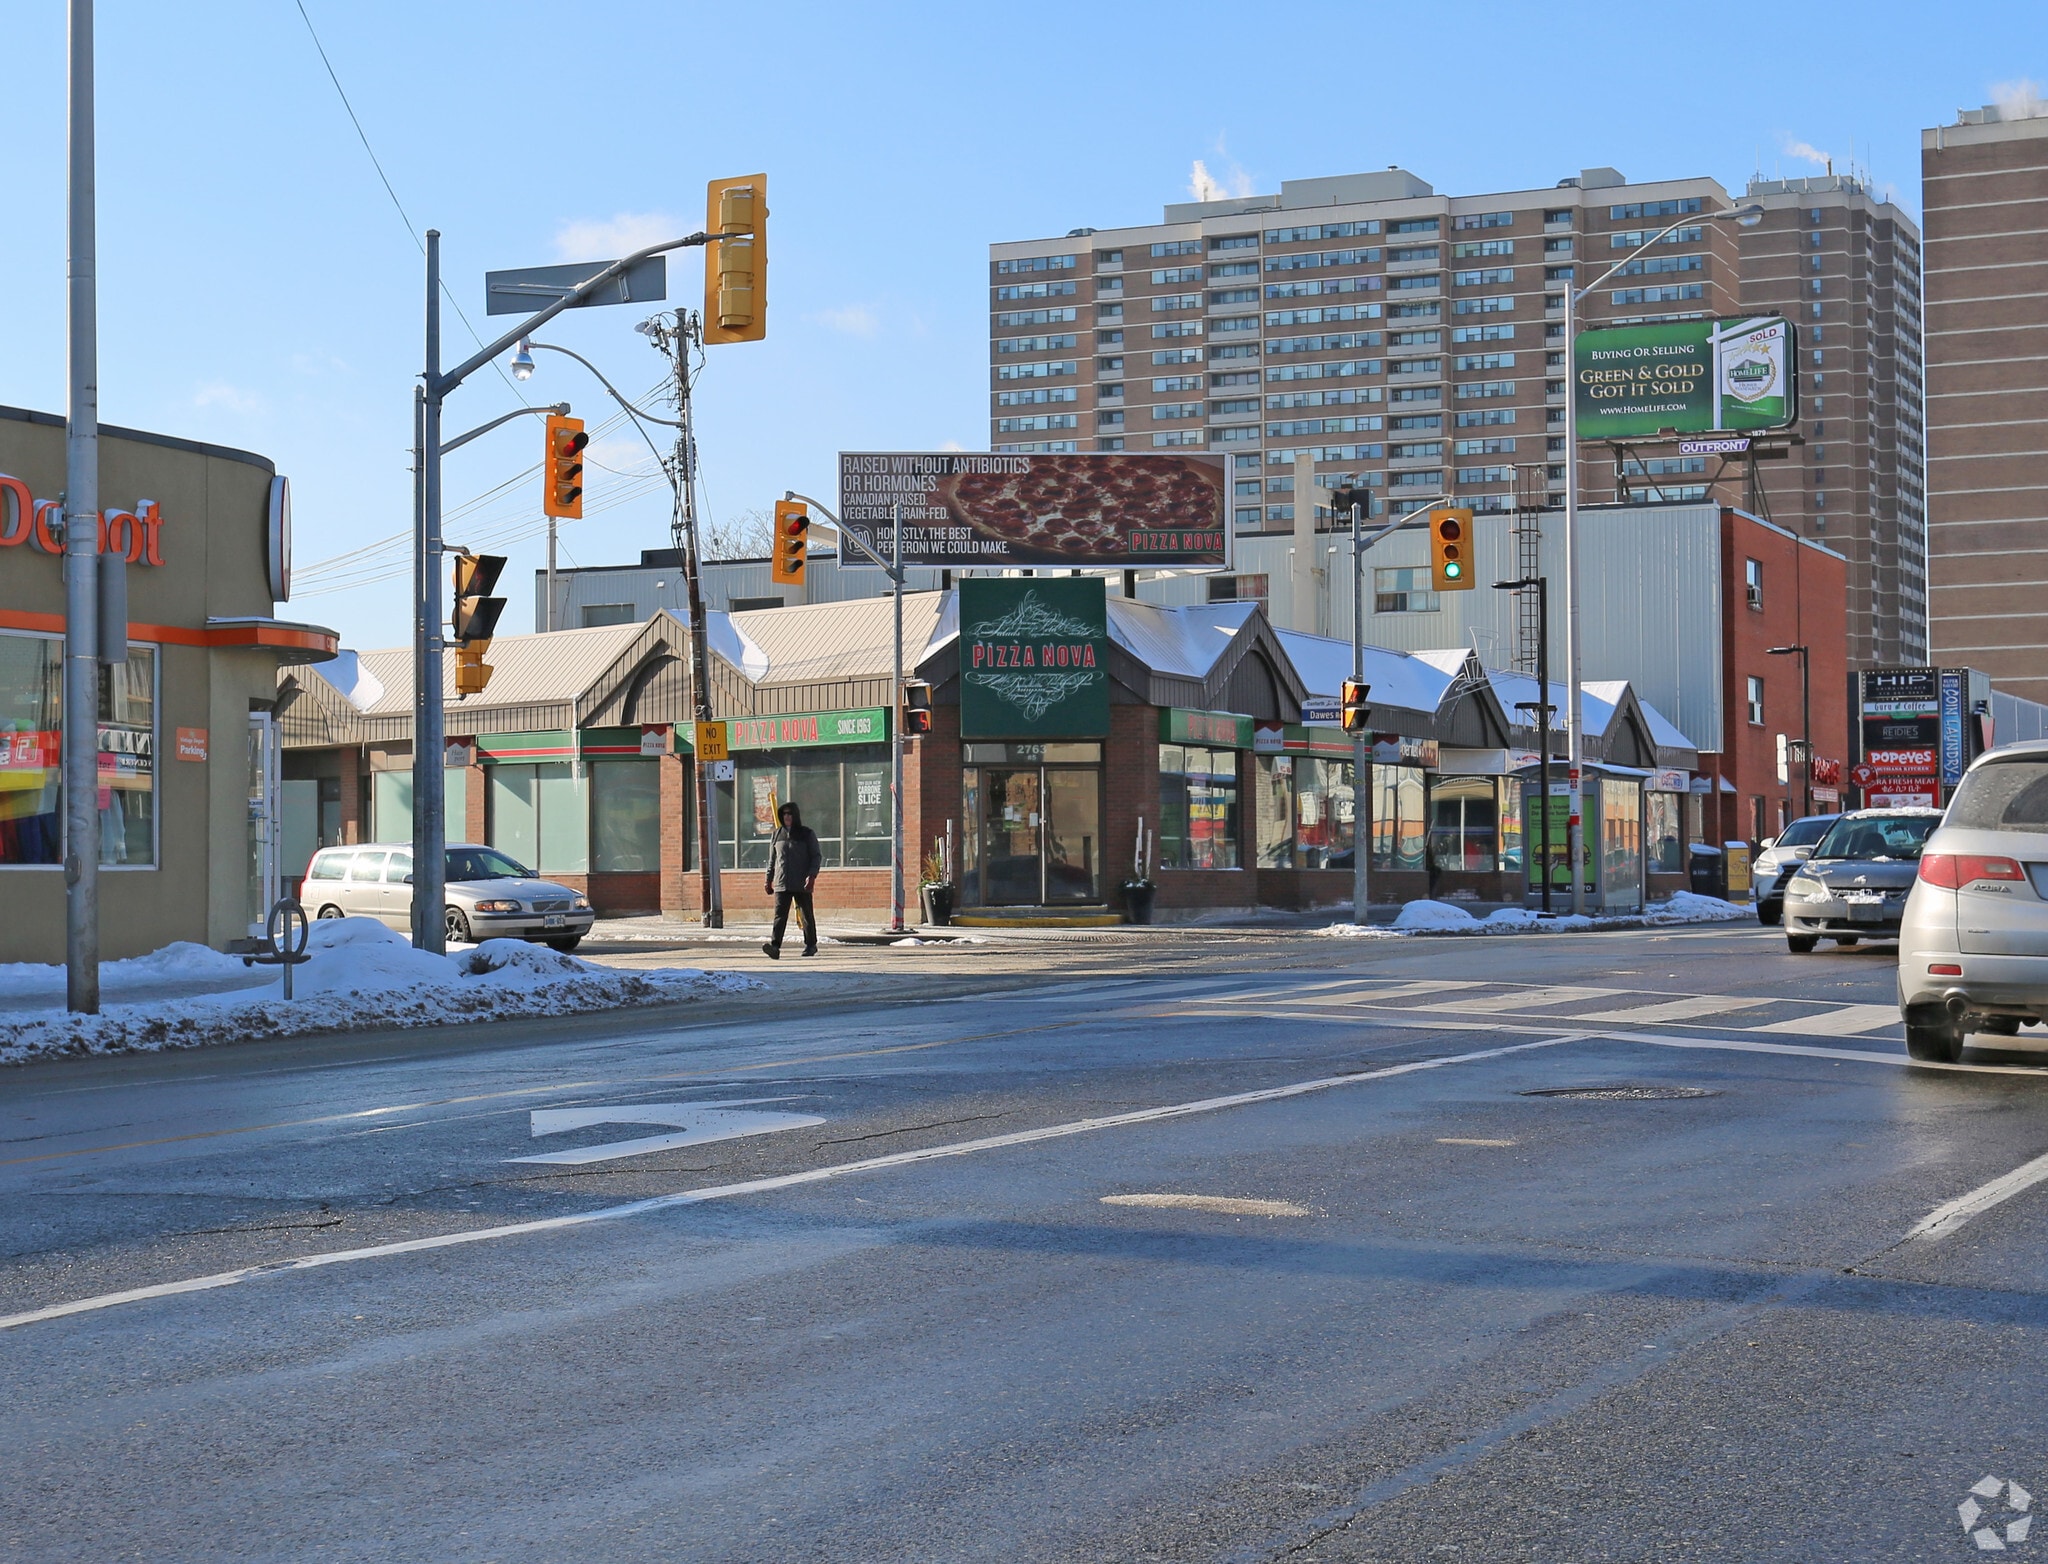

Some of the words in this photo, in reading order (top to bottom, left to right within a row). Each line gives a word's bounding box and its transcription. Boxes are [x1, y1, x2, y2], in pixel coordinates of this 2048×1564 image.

[1750, 328, 1777, 342] SOLD
[1592, 349, 1631, 360] BUYING
[1652, 345, 1695, 355] SELLING
[1580, 368, 1633, 384] GREEN
[1638, 366, 1651, 380] &
[1655, 364, 1704, 378] GOLD
[1589, 384, 1626, 399] GOT
[1631, 383, 1649, 396] IT
[1651, 380, 1694, 395] SOLD
[1681, 440, 1745, 453] OUTFRONT
[843, 457, 888, 474] RAISED
[892, 456, 949, 474] WITHOUT
[952, 456, 1030, 474] ANTIBIOTICS
[843, 475, 861, 491] OR
[864, 475, 939, 492] HORMONES.
[843, 493, 891, 505] CANADIAN
[843, 507, 894, 520] VEGETABLE
[900, 507, 949, 520] RAIN-FED.
[877, 527, 926, 541] HONSTLY,
[929, 527, 946, 540] THE
[949, 527, 972, 540] BEST
[877, 541, 930, 553] PEPERONI
[931, 541, 946, 553] WE
[949, 541, 979, 553] COULD
[981, 541, 1010, 553] MAKE.
[1132, 533, 1178, 550] PIZZA
[1183, 532, 1223, 550] NOVA
[972, 644, 1035, 668] PIZZA
[1042, 643, 1096, 668] NOVA
[1877, 676, 1927, 685] HIP
[1903, 702, 1926, 710] Coffee
[1945, 689, 1959, 716] COIN
[1310, 711, 1334, 719] Dawes
[706, 727, 717, 738] NO
[735, 719, 777, 746] PIZZA
[781, 716, 819, 742] NOVA
[837, 719, 856, 735] SINCE
[857, 718, 872, 733] 1963
[703, 744, 721, 755] EXIT
[1017, 745, 1047, 754] 2763
[1944, 720, 1959, 774] LAUNDRY
[858, 794, 881, 805] SLICE
[1974, 884, 2011, 893] ACURA
